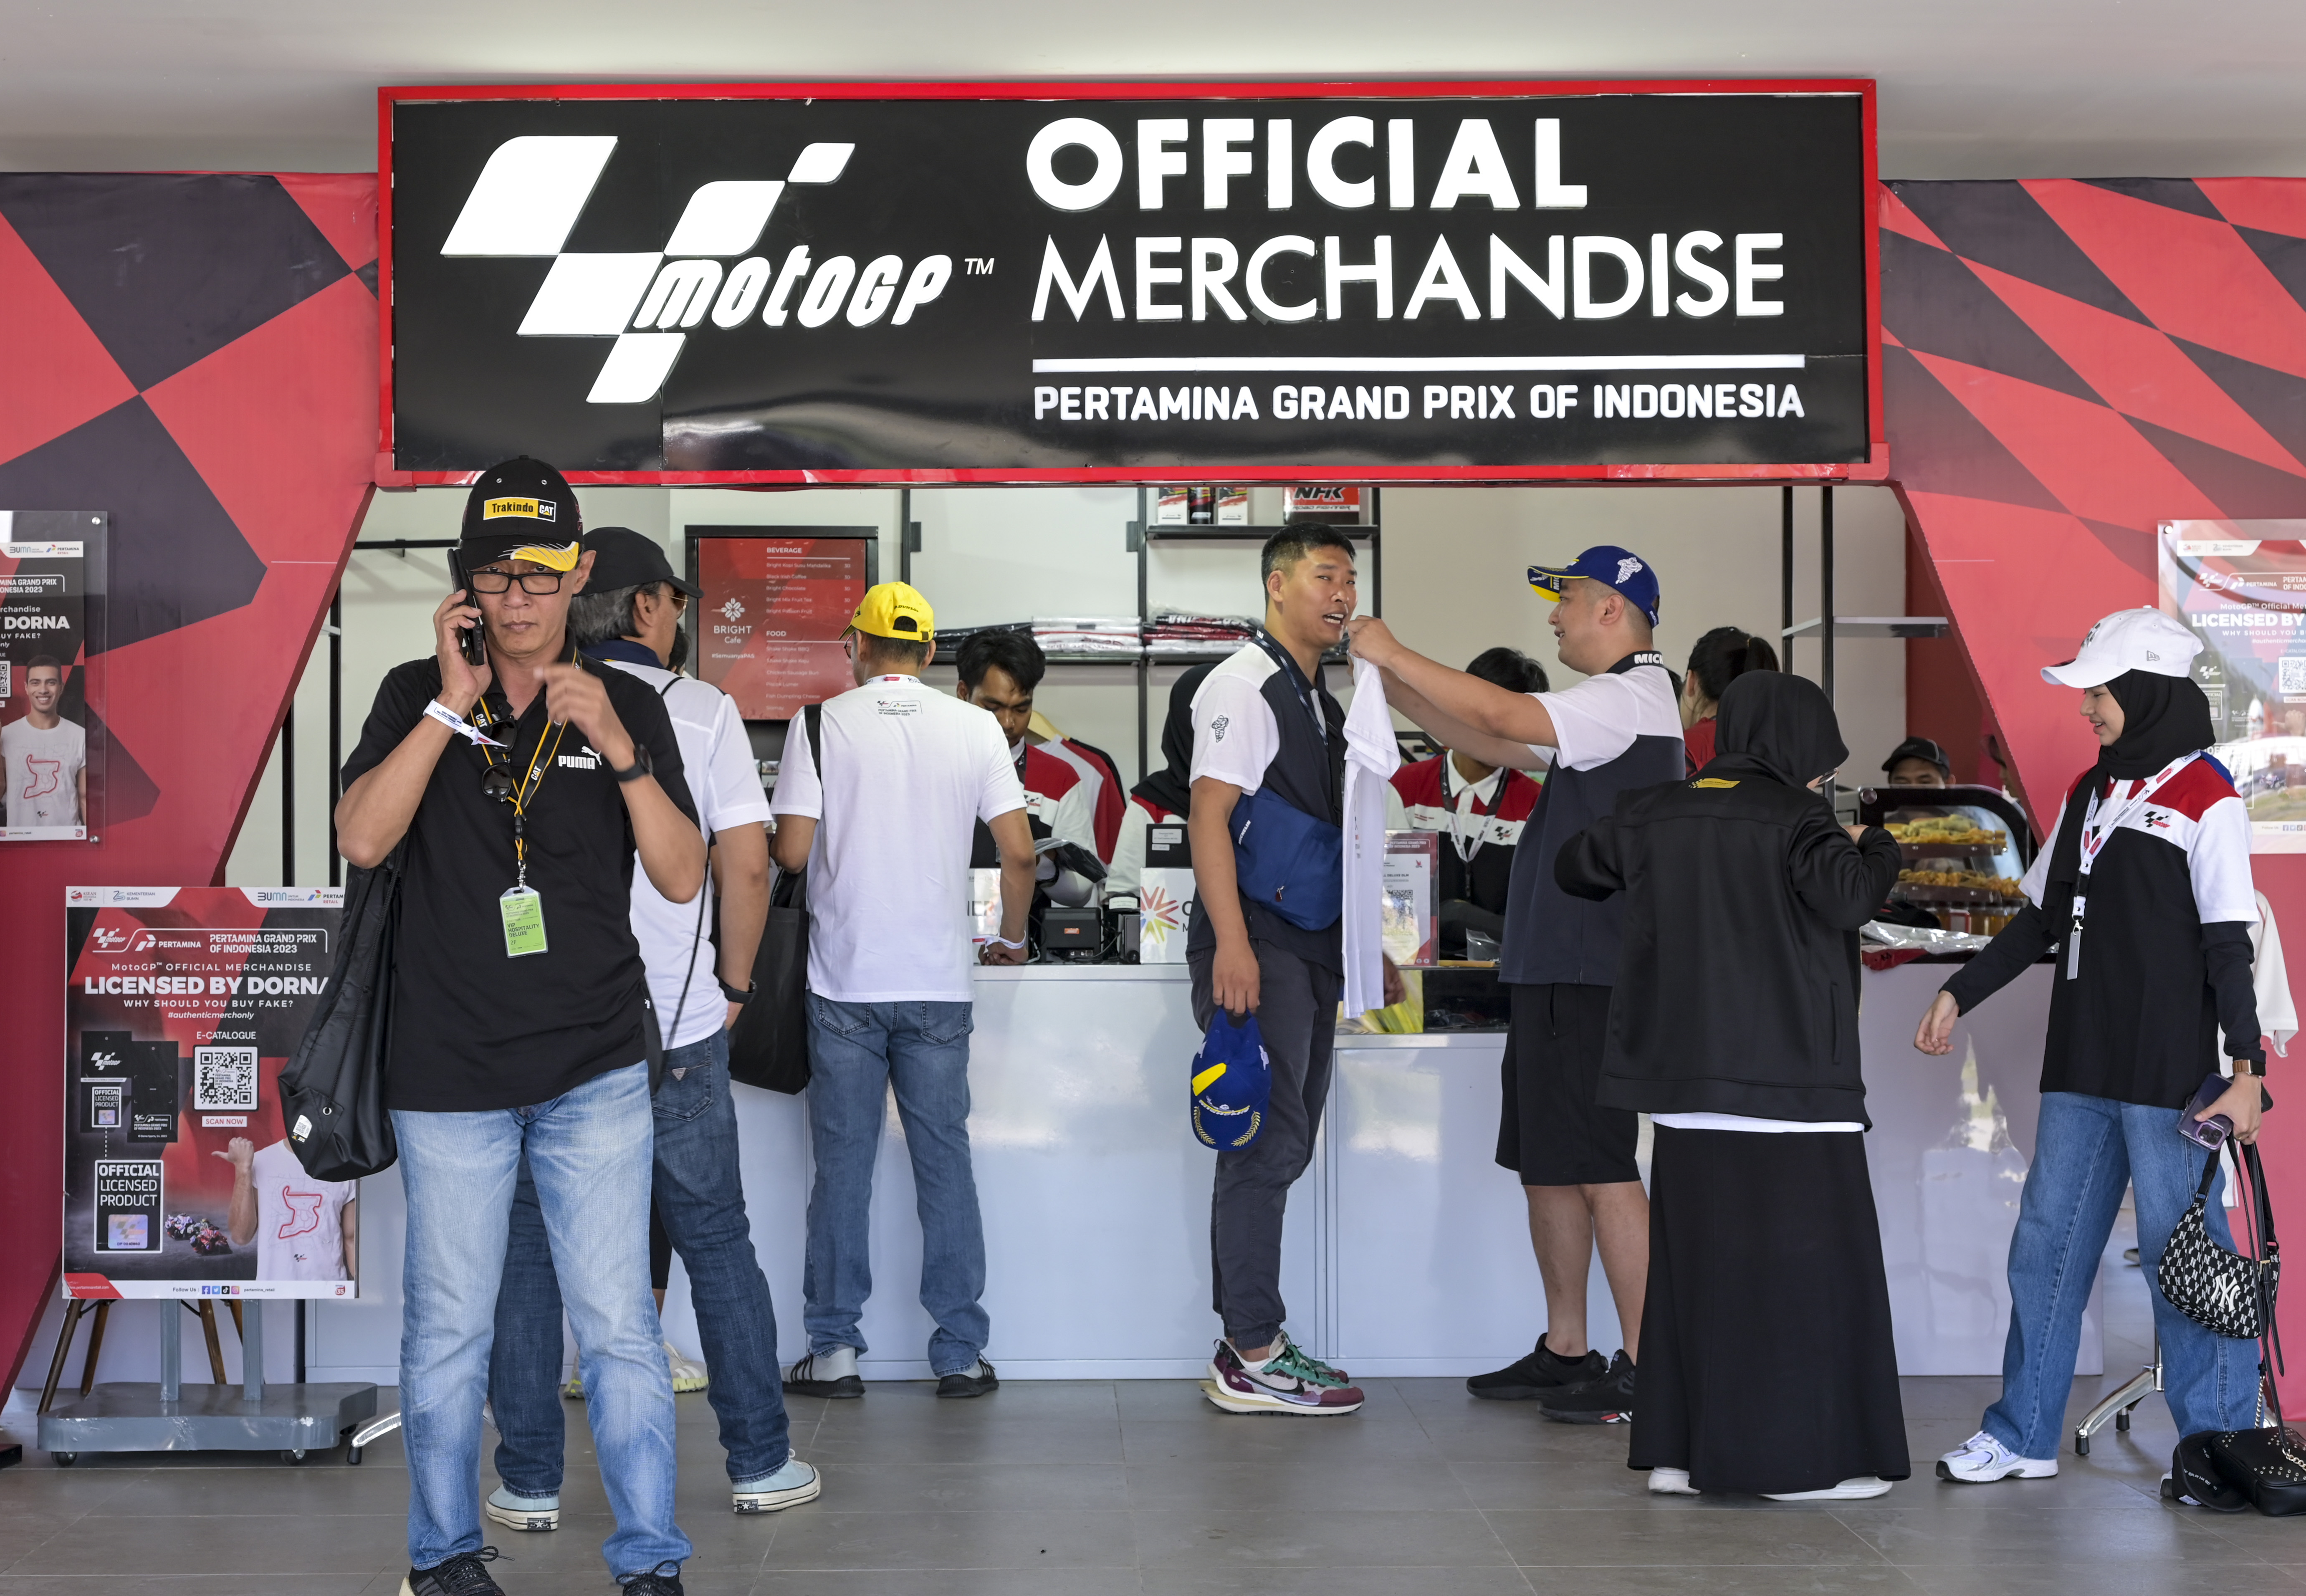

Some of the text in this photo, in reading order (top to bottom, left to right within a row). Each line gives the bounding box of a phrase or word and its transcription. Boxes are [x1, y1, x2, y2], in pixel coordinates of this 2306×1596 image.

[1027, 116, 1588, 210] OFFICIAL
[1031, 230, 1784, 321] MERCHANDISE
[1034, 383, 1805, 420] PERTAMINA GRAND PRIX OF INDONESIA
[492, 502, 554, 516] Trakindo CAT
[4, 616, 70, 629] DORNA
[2192, 613, 2305, 627] LICENSED BY
[475, 713, 487, 727] CAT
[558, 755, 595, 770] PUMA
[531, 765, 541, 781] CAT
[508, 923, 539, 933] HOSPITALITY
[210, 934, 317, 943] PERTAMINA GRAND PRIX
[210, 944, 297, 953] OF INDONESIA 2023
[85, 976, 205, 995] LICENSED
[210, 976, 242, 995] BY
[167, 1011, 254, 1020] #authenticmerchonly
[99, 1165, 159, 1177] OFFICIAL
[100, 1180, 157, 1192] LICENSED
[100, 1194, 157, 1206] PRODUCT
